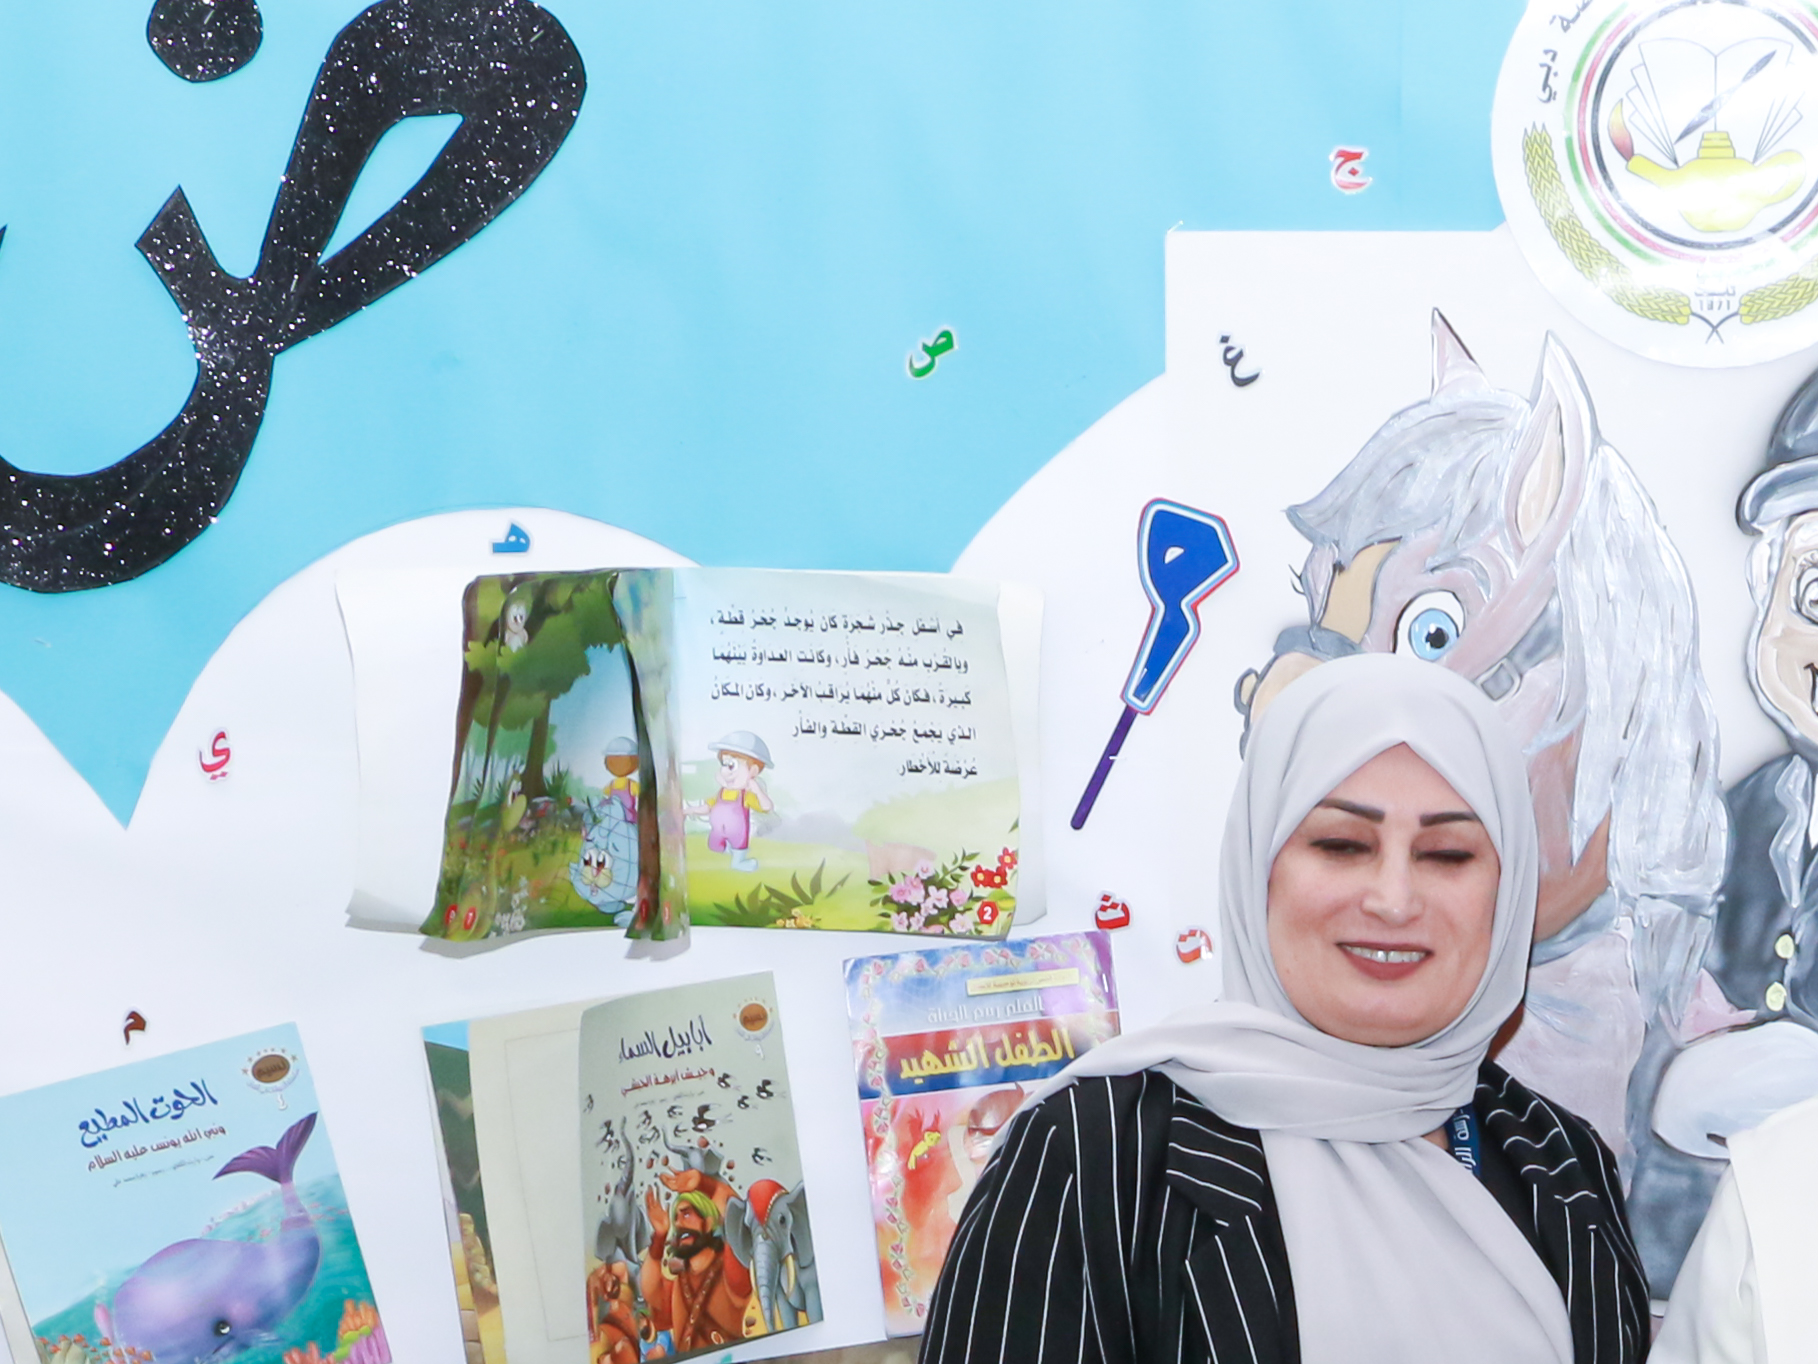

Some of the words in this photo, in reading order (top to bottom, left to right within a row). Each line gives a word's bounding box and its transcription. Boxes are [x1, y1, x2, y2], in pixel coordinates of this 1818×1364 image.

[1331, 147, 1372, 192] ج
[907, 325, 956, 380] ص
[945, 618, 964, 641] في
[982, 905, 993, 921] 2
[899, 1035, 991, 1085] الشهيد
[995, 1026, 1077, 1070] الطفل
[150, 1078, 219, 1121] الحوت
